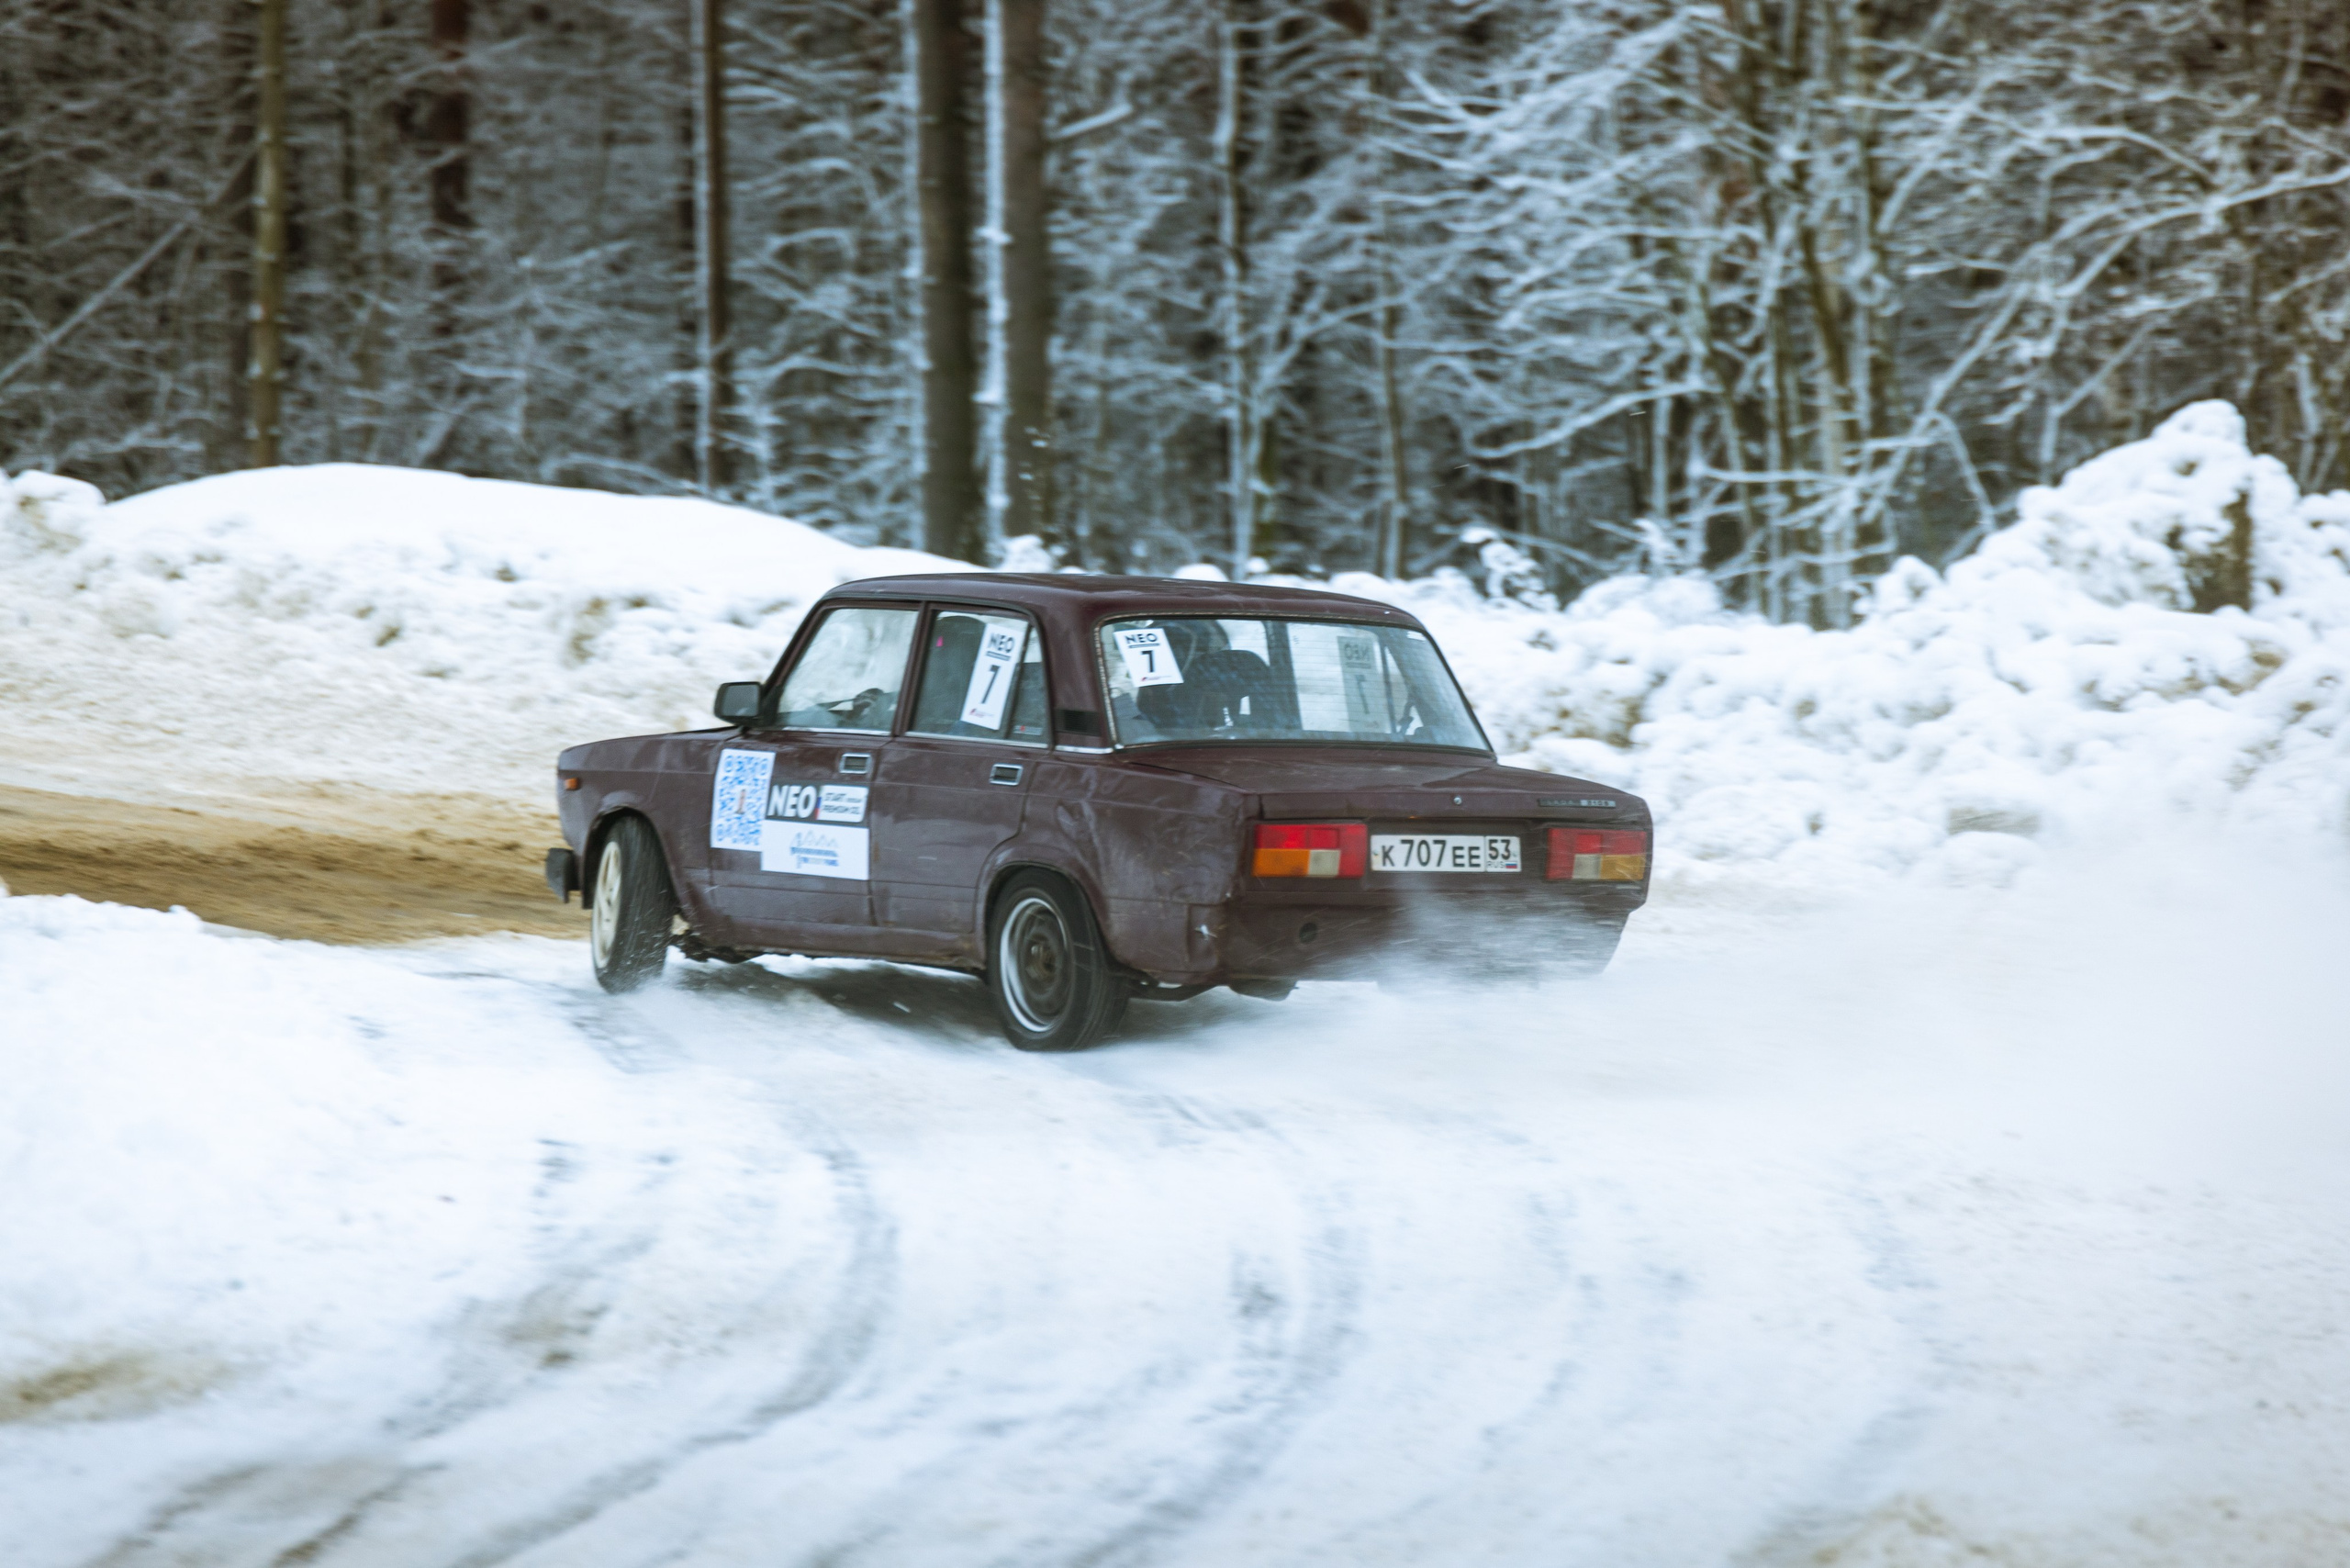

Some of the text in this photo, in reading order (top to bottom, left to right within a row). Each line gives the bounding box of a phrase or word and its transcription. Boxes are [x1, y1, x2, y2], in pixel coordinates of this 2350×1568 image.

[988, 633, 1015, 653] NEO
[1125, 633, 1158, 644] NEO
[1141, 650, 1155, 673] 7
[980, 665, 1001, 704] 7
[767, 785, 818, 818] NEO
[1488, 839, 1511, 860] 53
